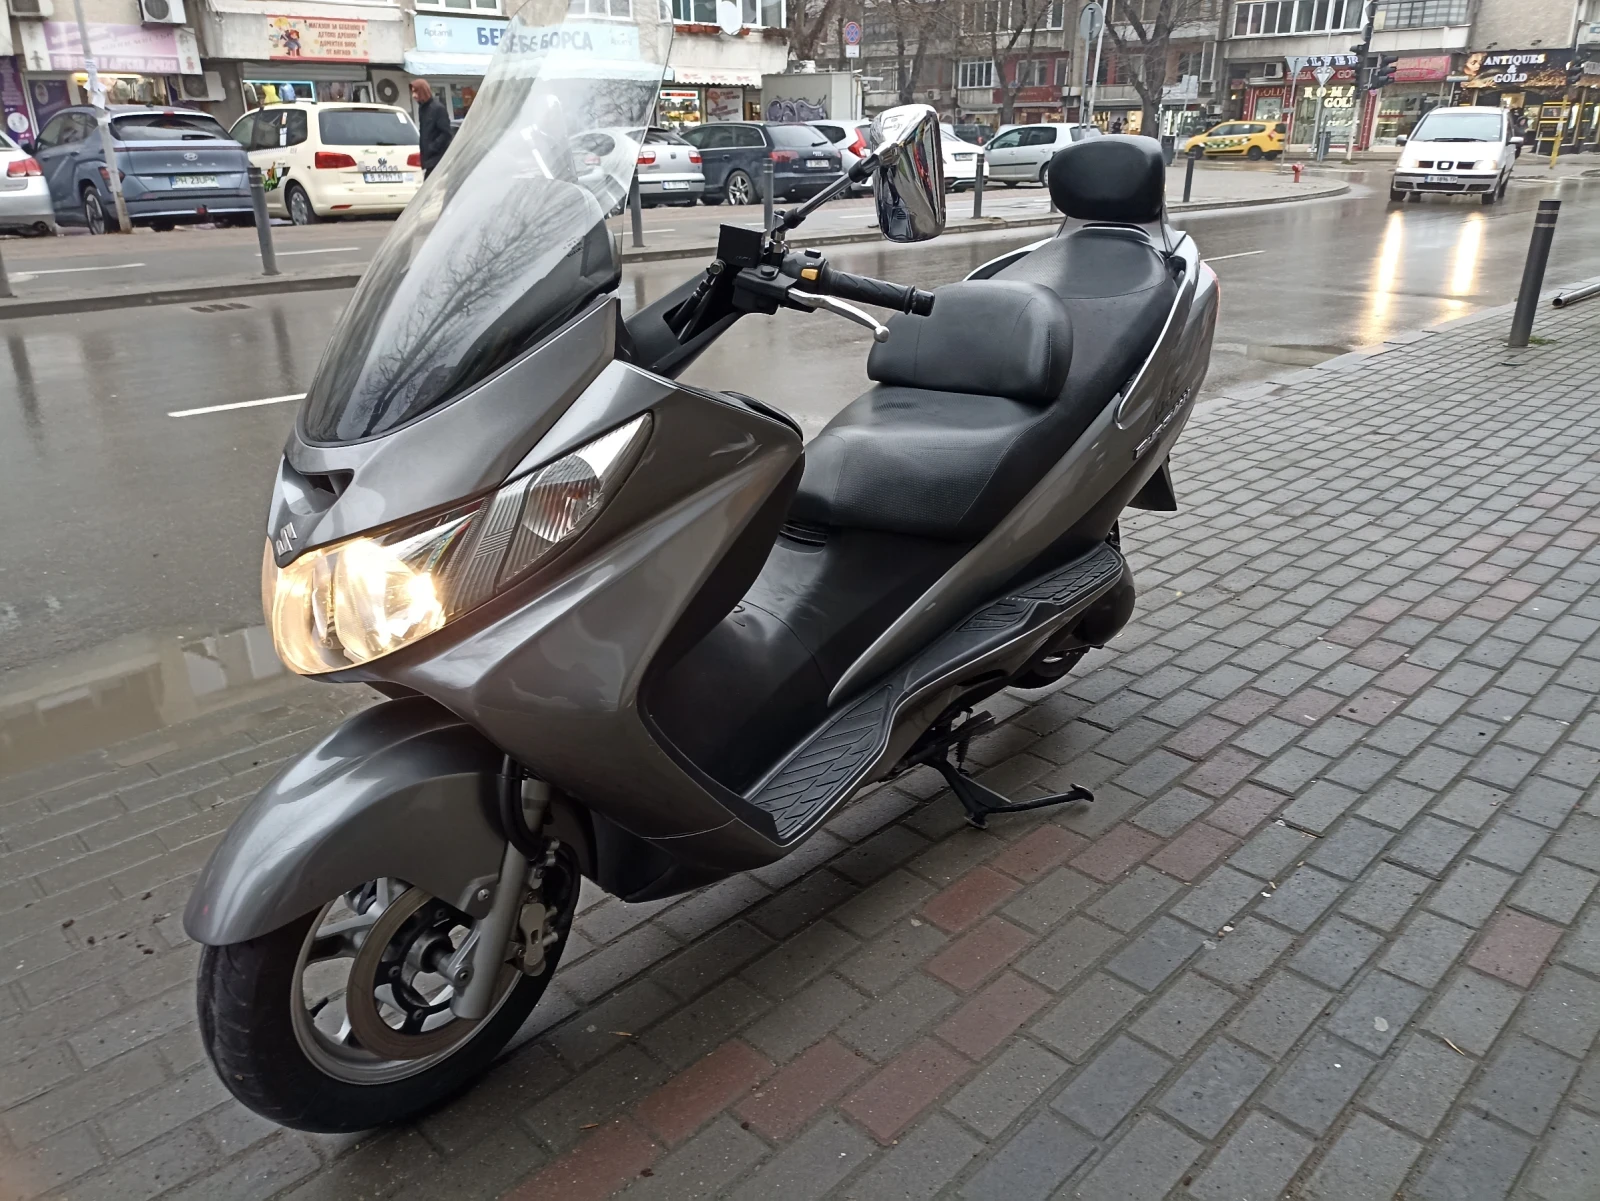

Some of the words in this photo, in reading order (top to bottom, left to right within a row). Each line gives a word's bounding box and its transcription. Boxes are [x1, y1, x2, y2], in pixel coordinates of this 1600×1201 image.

[540, 31, 593, 50] БОРСА
[1484, 54, 1546, 66] ANTIQUES
[1507, 65, 1517, 73] &
[1493, 73, 1528, 83] GOLD
